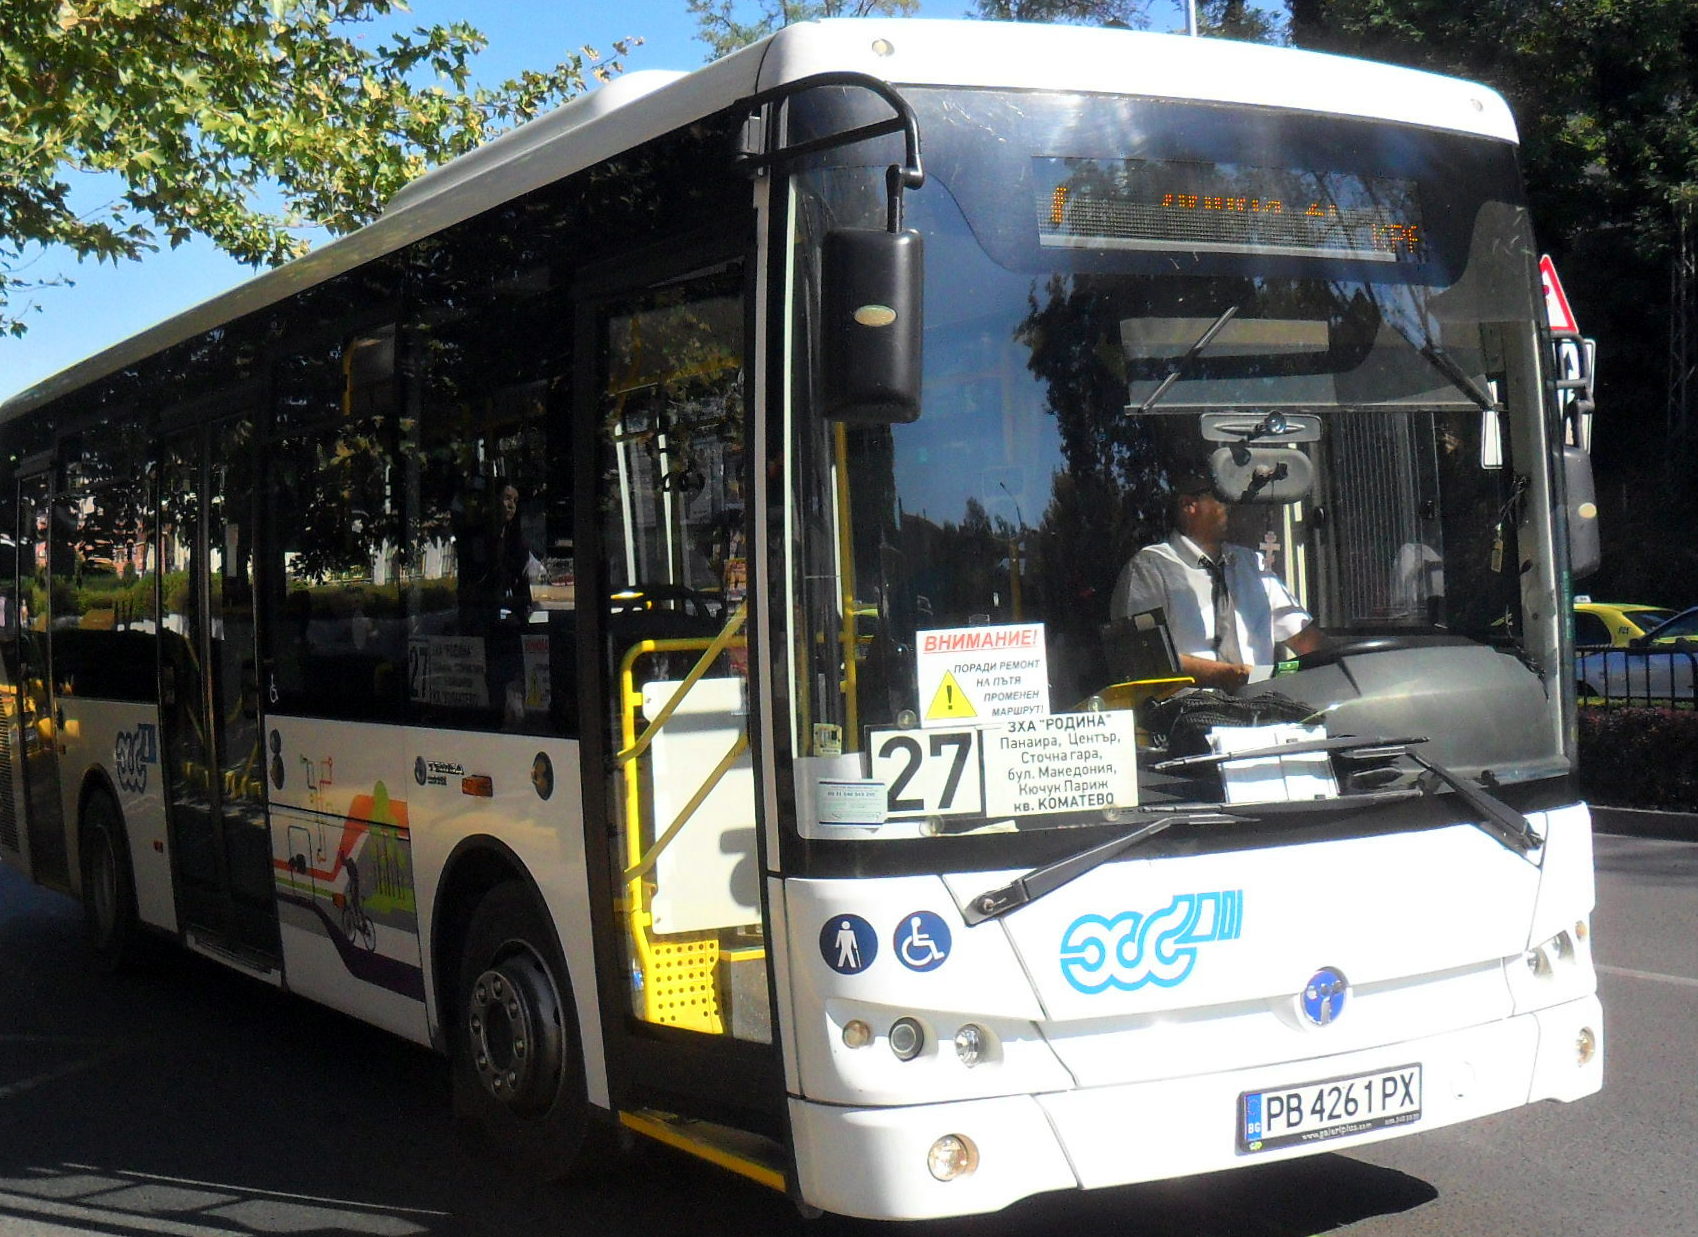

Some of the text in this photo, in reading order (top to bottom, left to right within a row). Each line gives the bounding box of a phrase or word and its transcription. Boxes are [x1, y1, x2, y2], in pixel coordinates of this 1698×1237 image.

[924, 630, 1038, 653] ВНИМАНИЕ!
[954, 659, 1041, 674] ПОРАДИ РЕМОНТ
[976, 676, 1022, 688] НА ПЪТЯ
[984, 690, 1040, 702] ПРОМЕНЕН
[992, 705, 1044, 717] МАРШРУТ!
[1008, 713, 1112, 733] ЗХА "РОДИНА"
[1000, 733, 1121, 751] Панаира, Център,
[1021, 749, 1103, 764] Сточна гара,
[878, 732, 972, 812] 27
[1008, 763, 1117, 784] бул. Македония,
[1019, 779, 1109, 797] Кючук Париж
[1014, 792, 1114, 812] кв. КОМАТЕВО
[1267, 1072, 1415, 1132] PB 4261 PX
